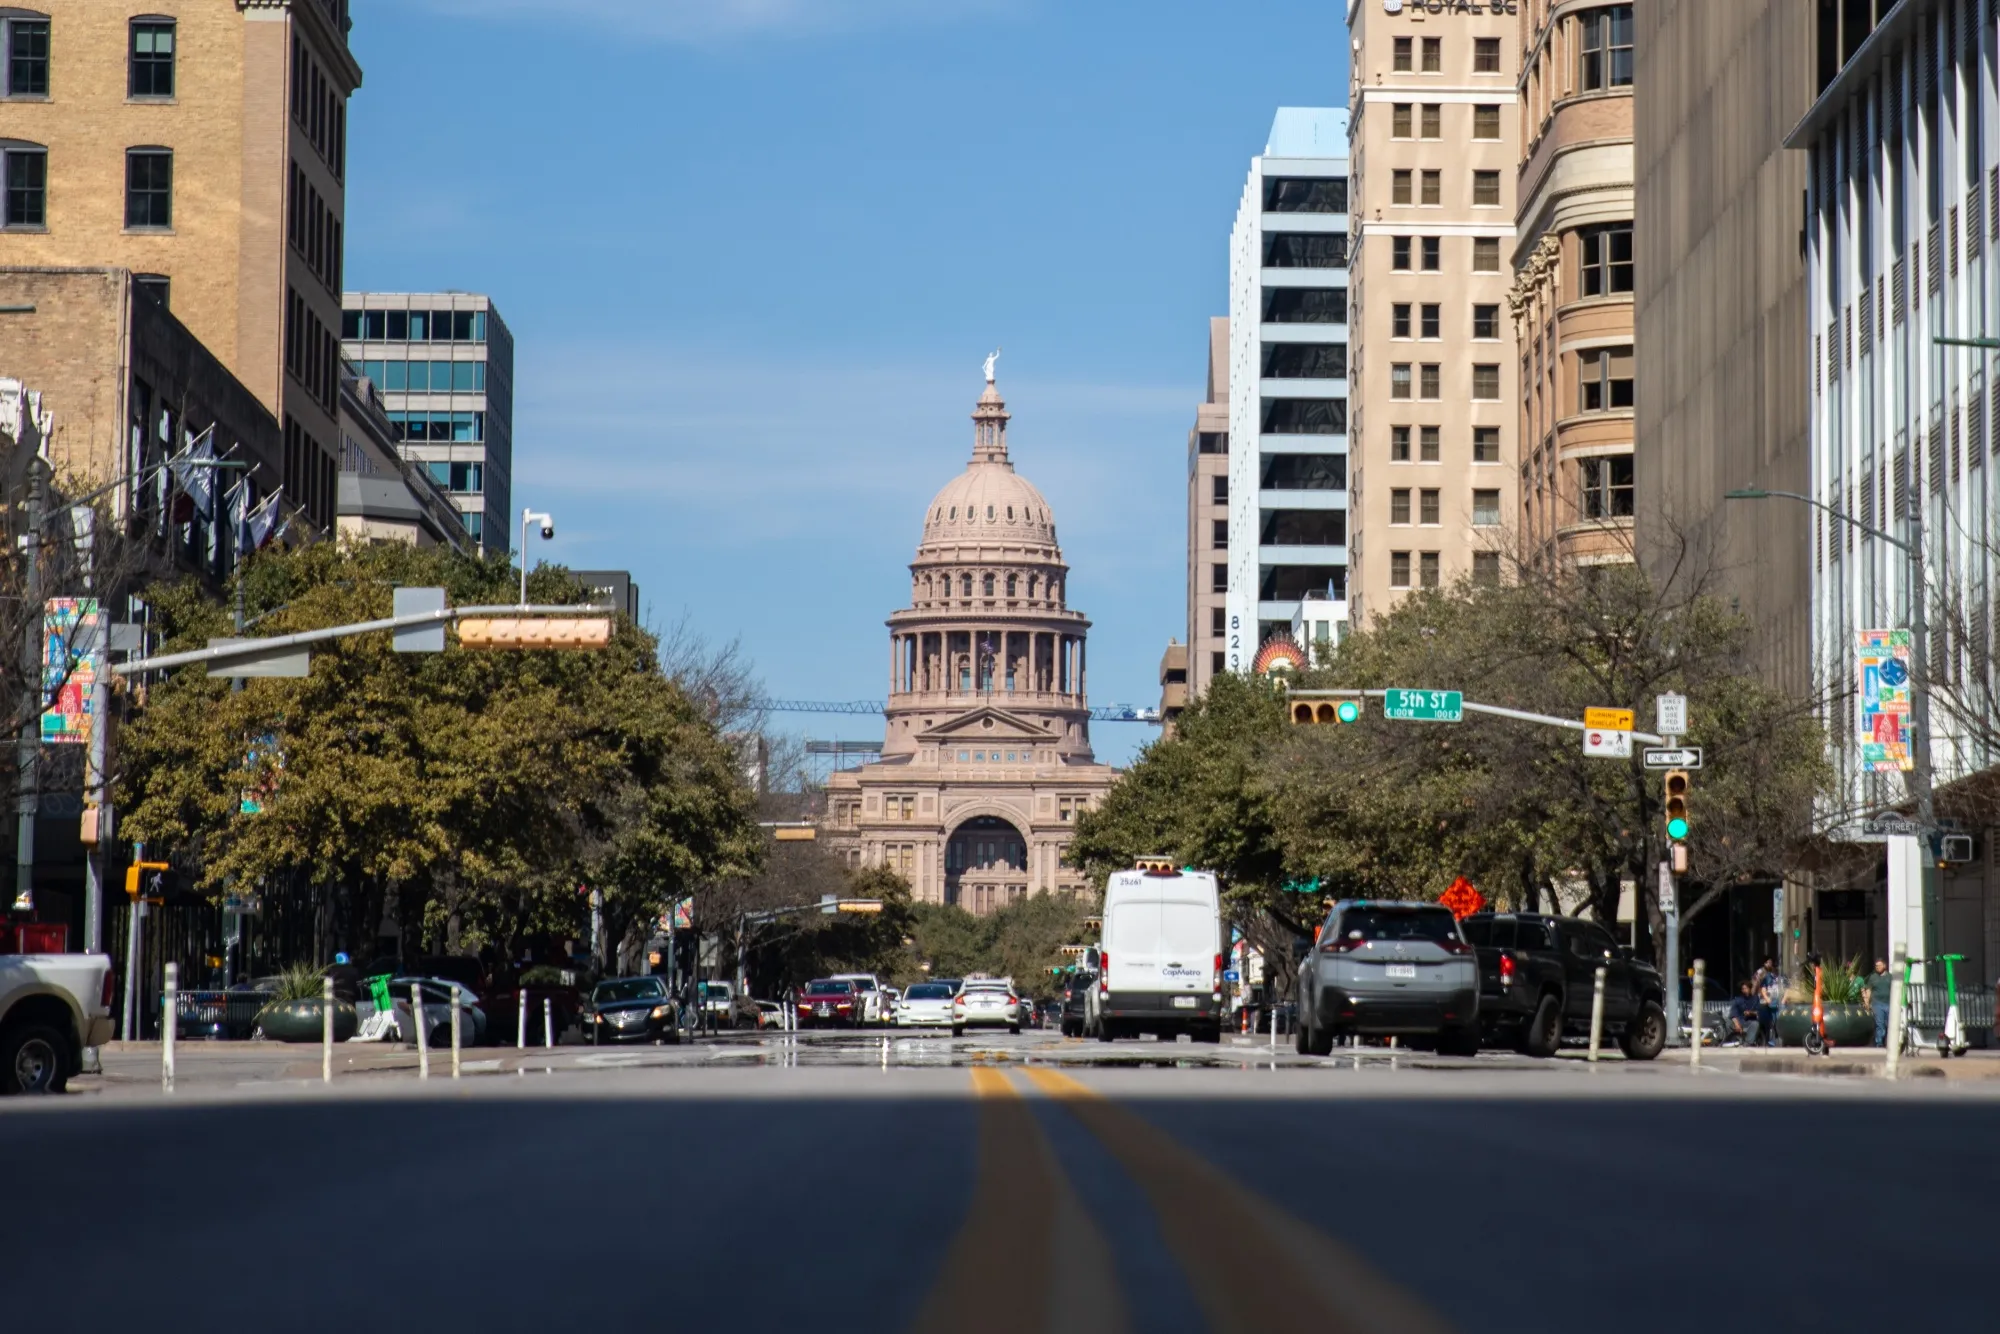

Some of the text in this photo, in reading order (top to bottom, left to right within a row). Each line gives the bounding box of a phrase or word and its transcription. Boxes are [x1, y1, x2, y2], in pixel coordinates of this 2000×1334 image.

[1231, 615, 1240, 668] 823
[1400, 691, 1447, 709] 5th ST
[1650, 753, 1682, 762] ONE WAY
[1885, 822, 1915, 831] STREET
[1162, 968, 1201, 977] CapMetro
